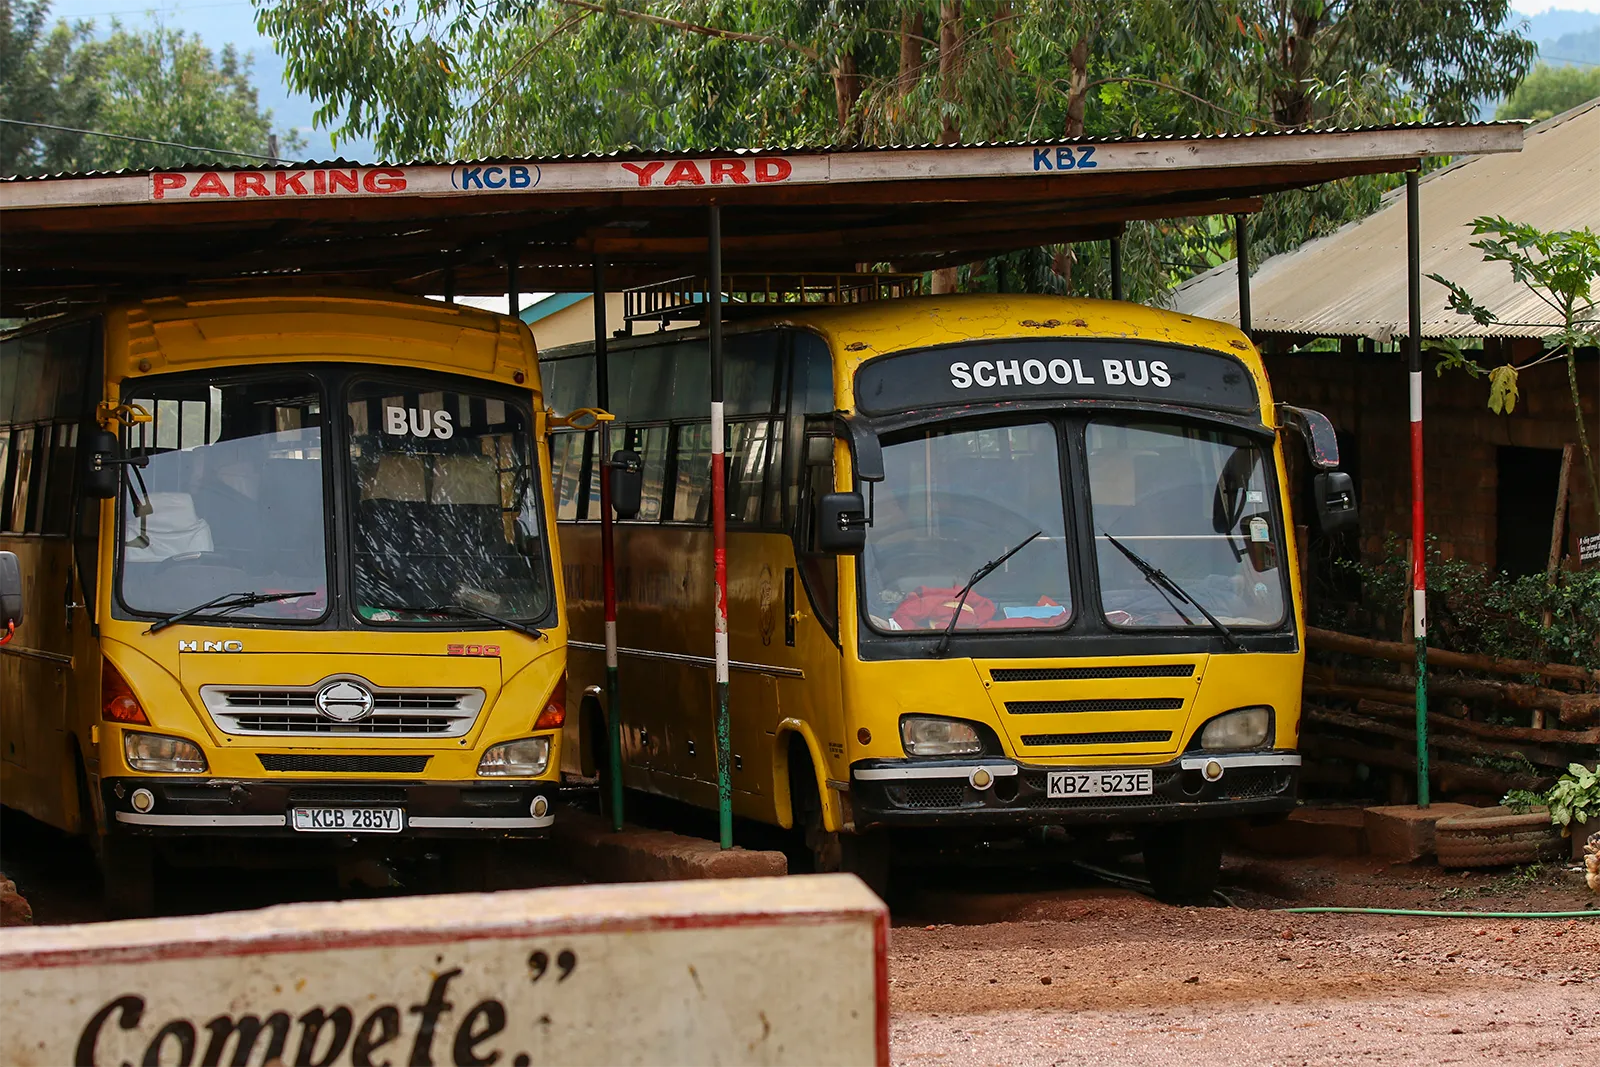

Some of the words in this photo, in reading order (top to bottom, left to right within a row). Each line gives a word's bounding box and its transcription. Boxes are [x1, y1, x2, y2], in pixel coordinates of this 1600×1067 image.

[152, 168, 407, 199] PARKING
[450, 164, 541, 190] (KCB)
[621, 157, 792, 187] YARD
[1033, 146, 1097, 171] KBZ
[950, 359, 1095, 389] SCHOOL
[1102, 359, 1172, 387] BUS
[387, 406, 453, 439] BUS
[447, 644, 500, 656] 500
[1051, 776, 1090, 794] KBZ
[1101, 774, 1151, 793] 523E
[312, 809, 345, 827] KCB
[352, 810, 393, 828] 285Y
